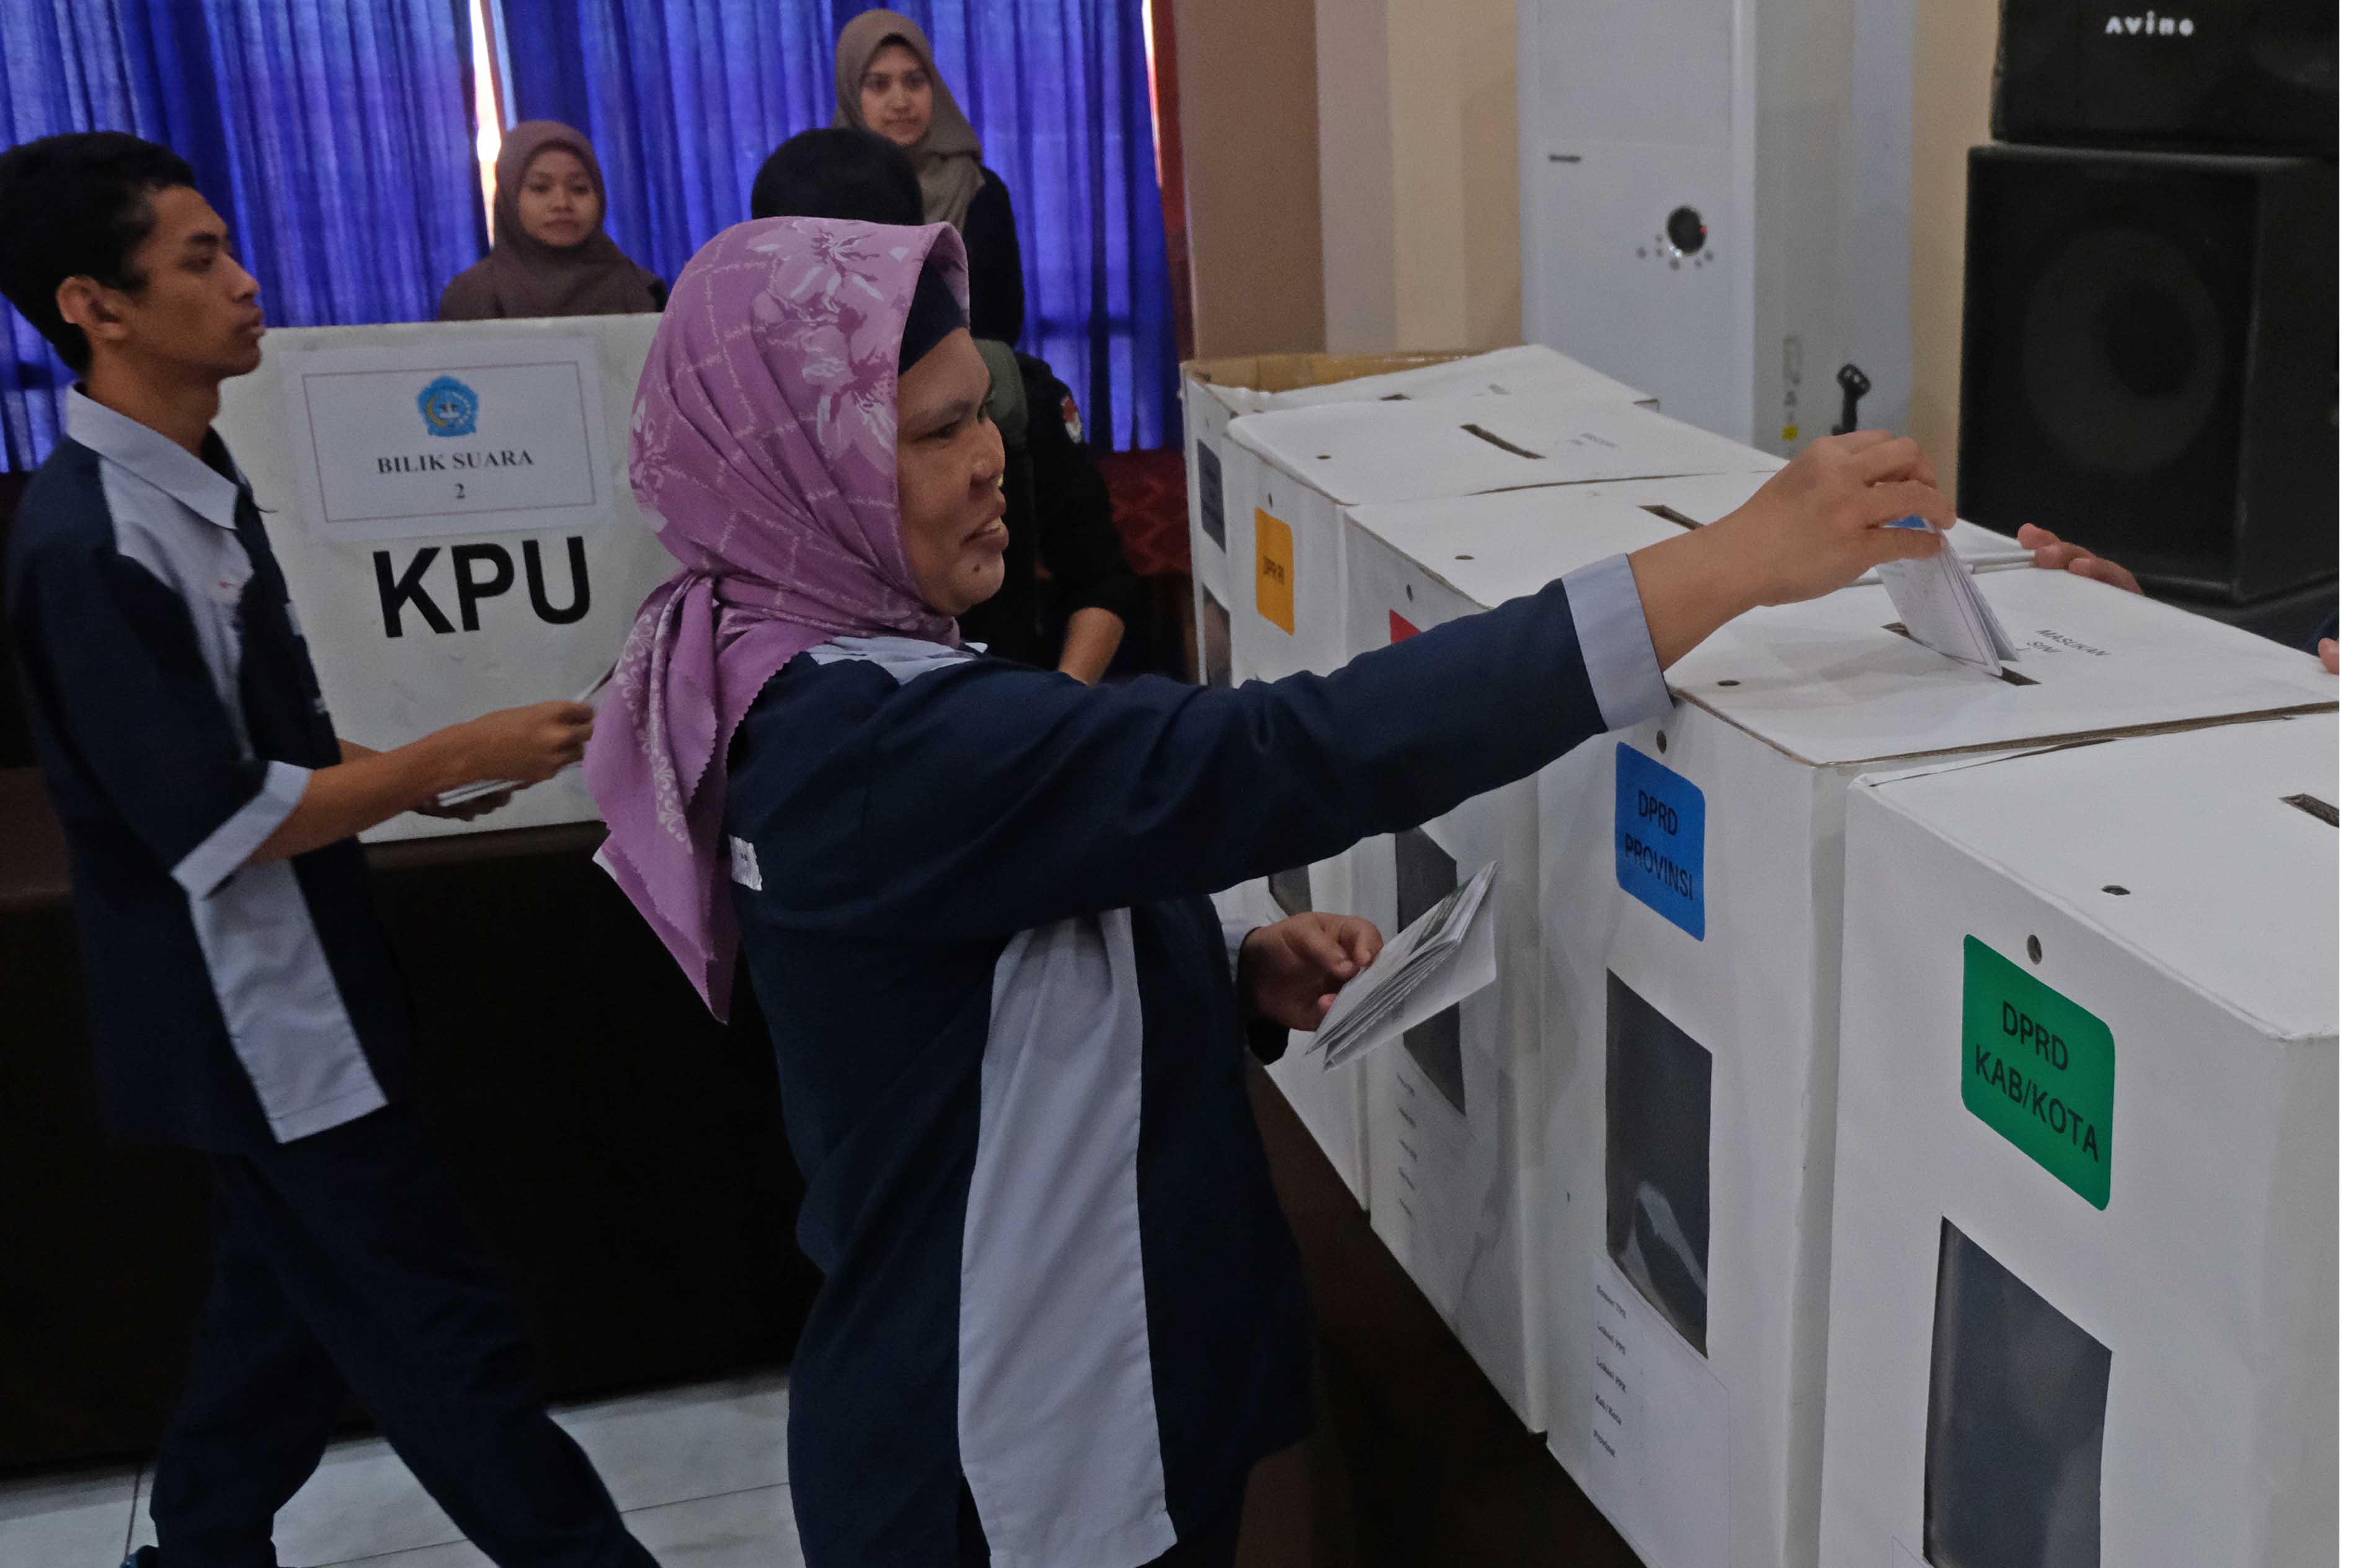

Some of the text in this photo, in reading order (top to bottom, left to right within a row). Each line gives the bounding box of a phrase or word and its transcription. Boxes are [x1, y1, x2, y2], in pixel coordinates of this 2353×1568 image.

[377, 449, 534, 474] BILIK SUARA
[455, 482, 466, 500] 2
[373, 535, 591, 639] KPU
[2026, 641, 2063, 653] SINI
[2035, 629, 2112, 656] MASUKAN
[1637, 789, 1679, 838] DPRD
[1624, 832, 1694, 902] PROVINSI
[2002, 1000, 2069, 1072] DPRD
[1975, 1043, 2099, 1163] KAB/KOTA
